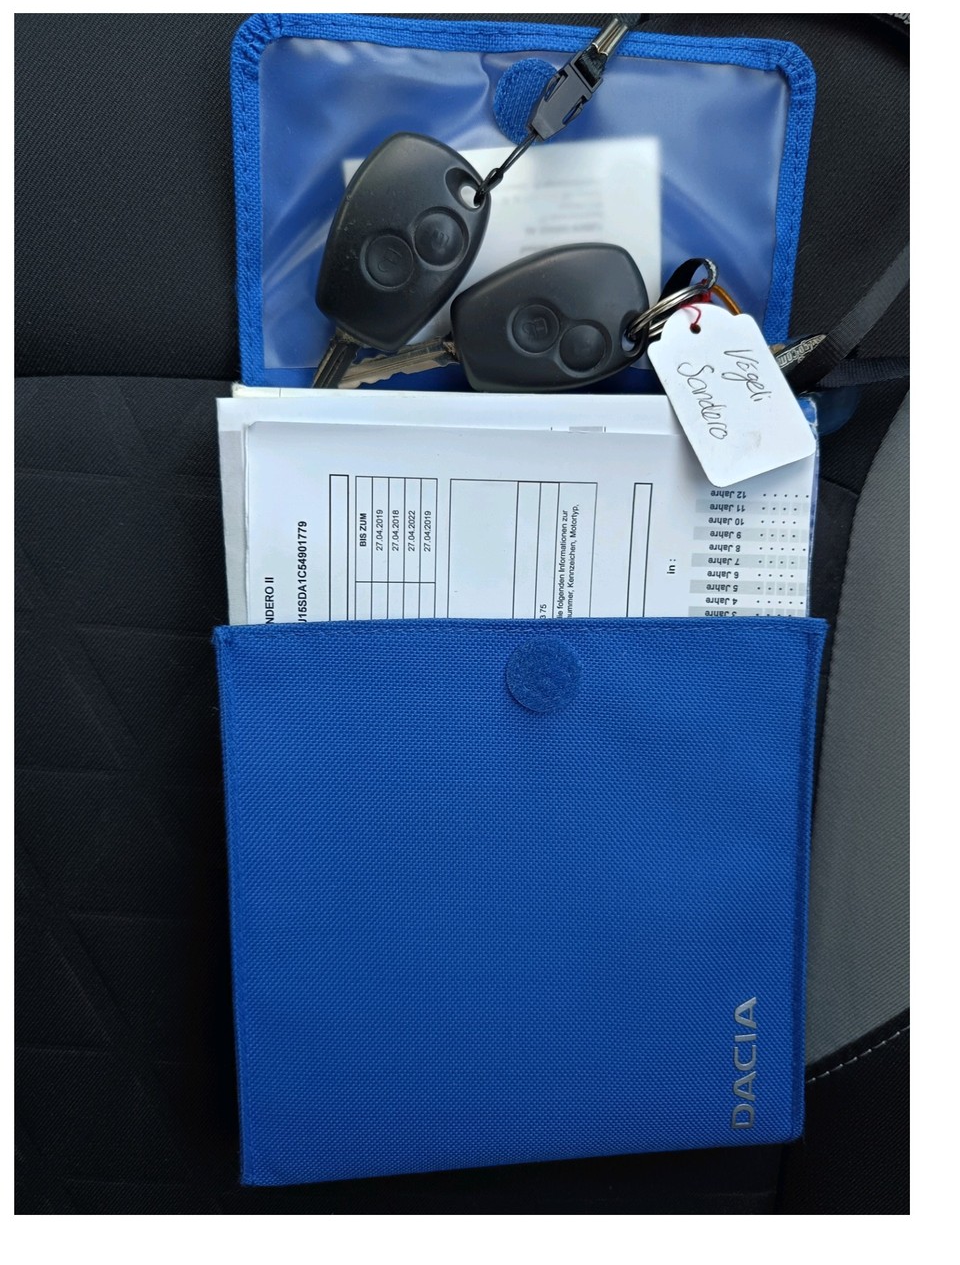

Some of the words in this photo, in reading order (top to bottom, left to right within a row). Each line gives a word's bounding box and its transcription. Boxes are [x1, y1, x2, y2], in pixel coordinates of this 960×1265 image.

[710, 490, 734, 498] Jahre
[359, 513, 367, 531] ZUM
[392, 510, 400, 551] 27.04.2018
[408, 510, 416, 552] 27.04.2022
[424, 510, 432, 552] 27.04.2019
[570, 504, 580, 538] Motortyp,
[708, 517, 732, 525] Jahre
[359, 533, 367, 547] BIS
[559, 523, 567, 573] Informationen
[567, 540, 577, 588] Kennzeichen,
[667, 565, 676, 574] in
[708, 557, 732, 565] Jahre
[557, 574, 566, 609] folgenden
[705, 597, 730, 605] Jahre
[540, 604, 547, 613] 75
[731, 996, 758, 1129] DACIA
